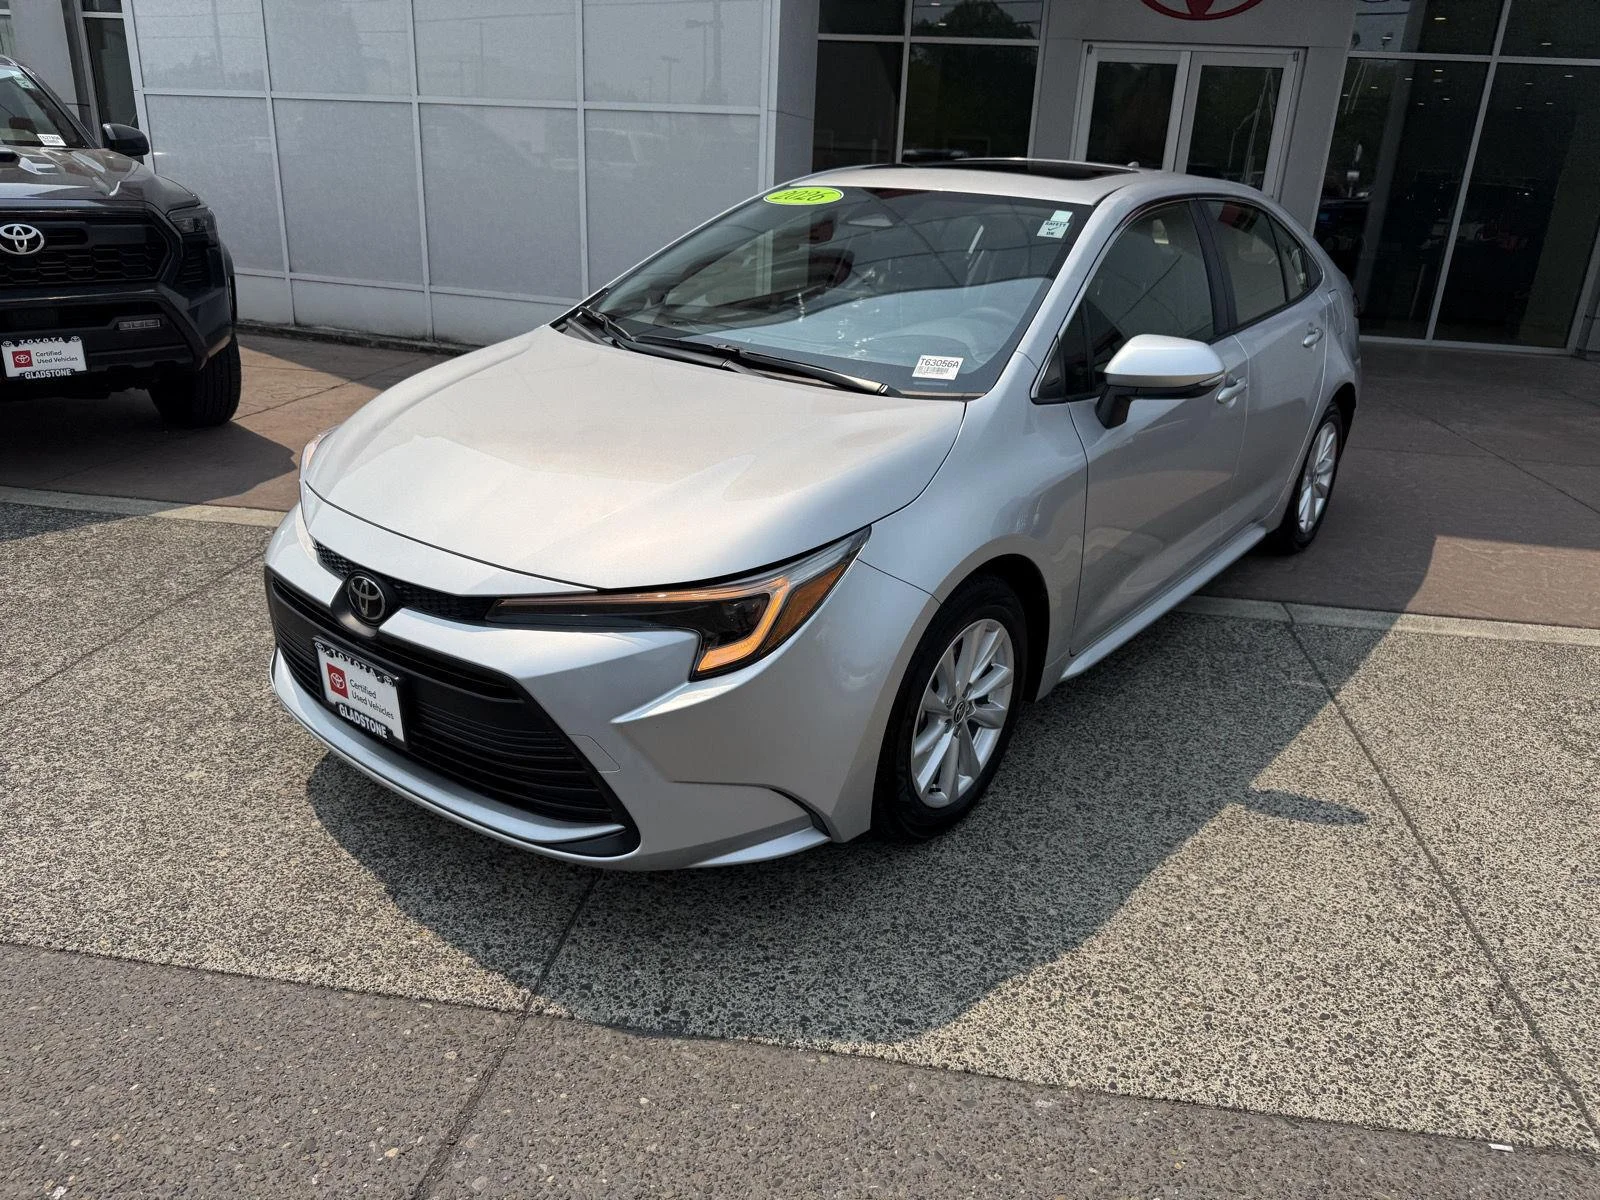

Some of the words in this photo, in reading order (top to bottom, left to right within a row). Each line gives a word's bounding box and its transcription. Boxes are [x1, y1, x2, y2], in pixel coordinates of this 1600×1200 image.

[19, 336, 64, 345] TOYOTA
[920, 358, 959, 368] T63056A
[24, 368, 72, 380] GLADSTONE
[329, 648, 377, 677] TOYOTA
[349, 678, 377, 699] Certified
[351, 690, 368, 705] Used
[368, 699, 395, 720] Vehicles
[338, 703, 388, 739] GLADSTONE
